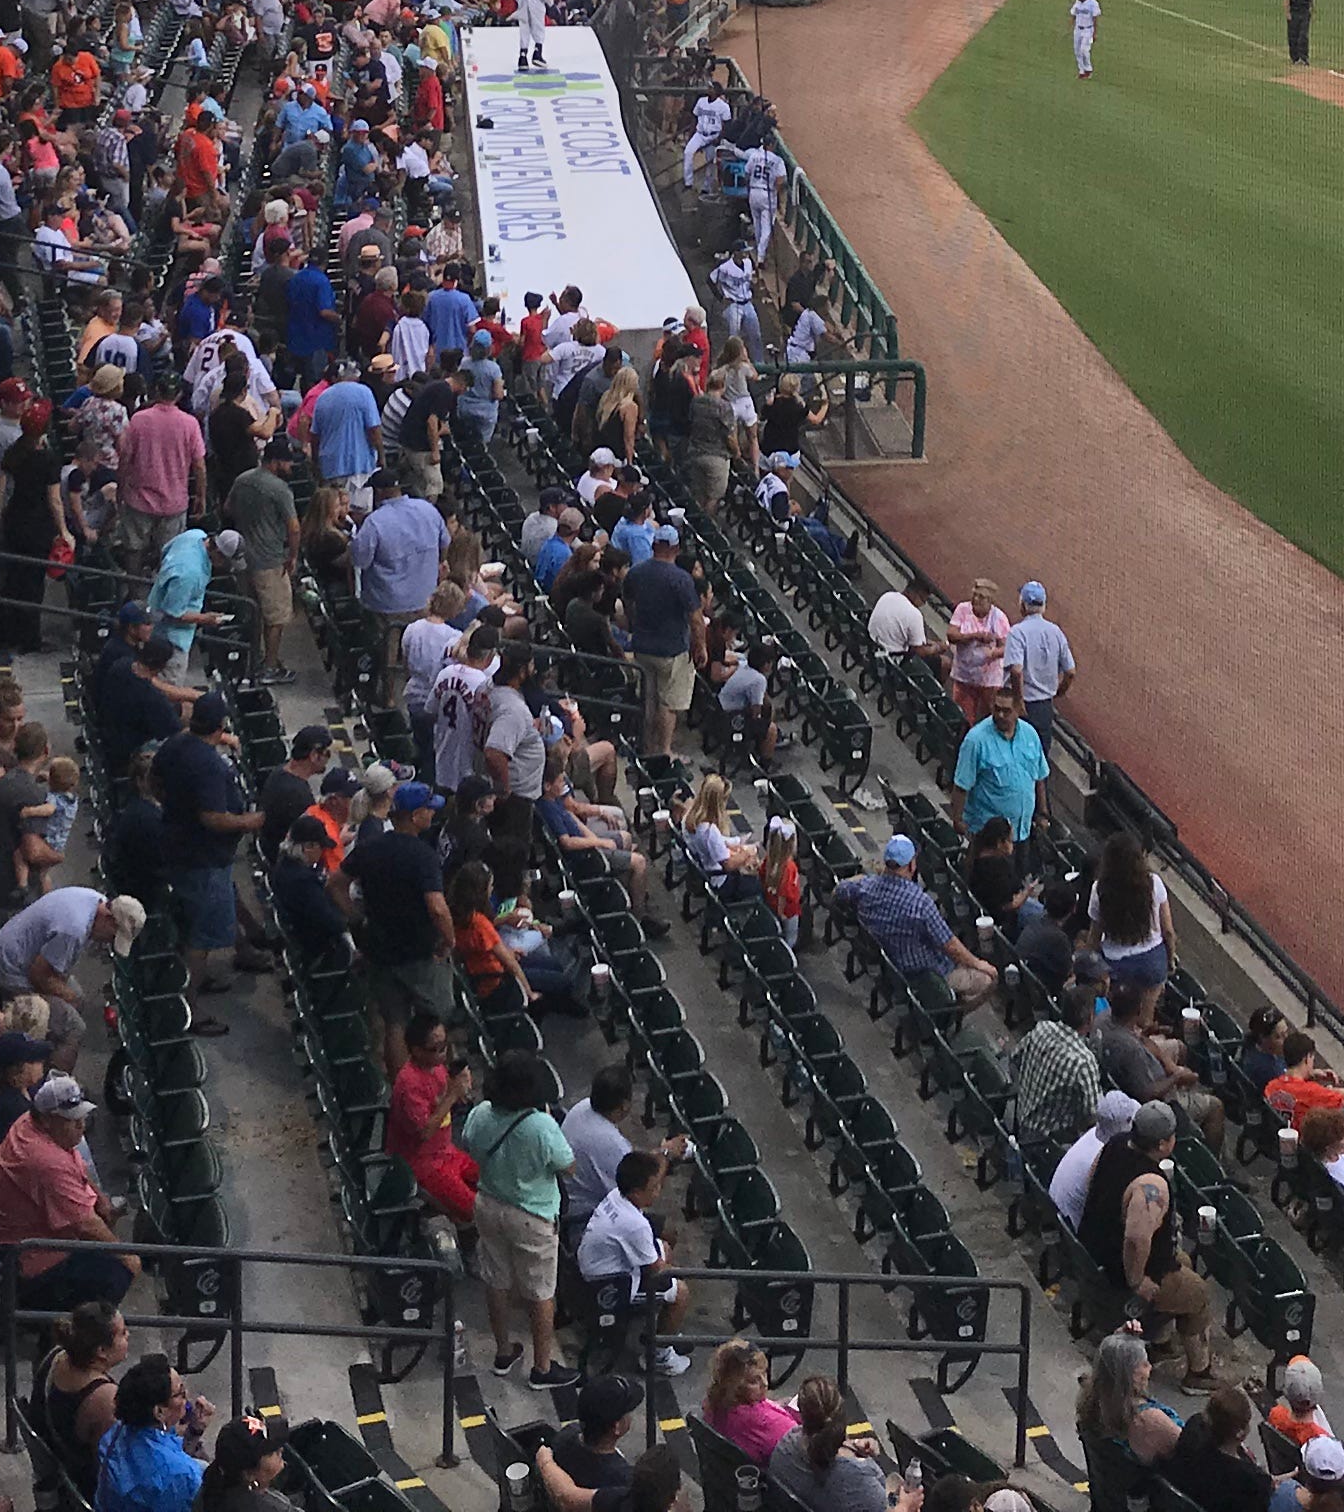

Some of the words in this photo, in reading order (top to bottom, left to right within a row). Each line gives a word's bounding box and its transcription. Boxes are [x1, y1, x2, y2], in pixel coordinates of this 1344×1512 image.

[480, 97, 548, 156] GROWTH
[550, 96, 614, 128] GULF
[559, 129, 631, 175] COAST
[753, 164, 770, 180] 25
[490, 157, 567, 242] VENTURES
[443, 694, 457, 728] 4
